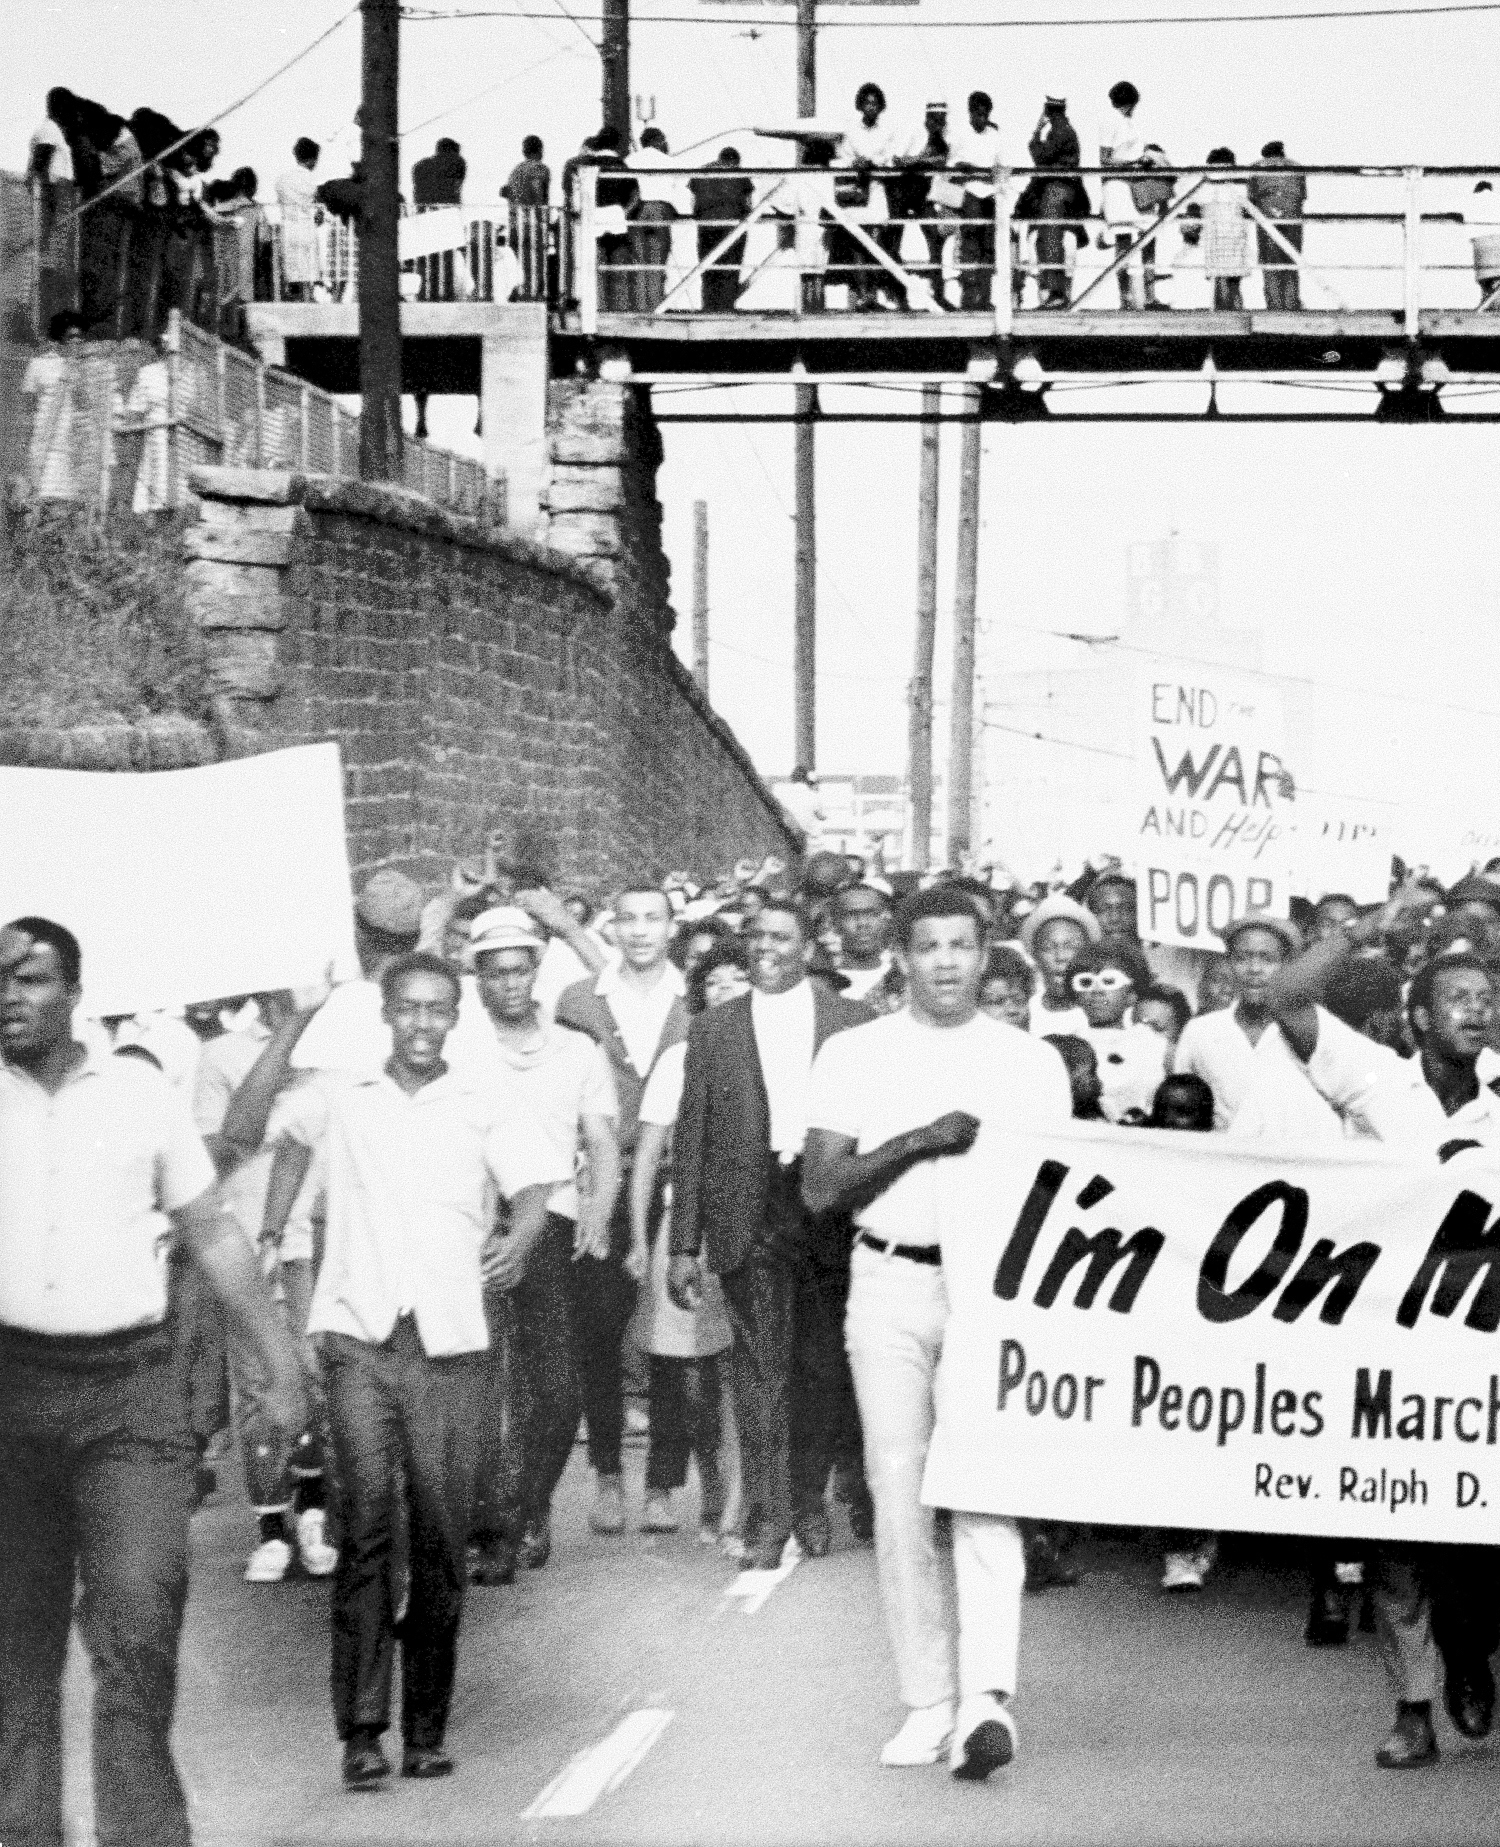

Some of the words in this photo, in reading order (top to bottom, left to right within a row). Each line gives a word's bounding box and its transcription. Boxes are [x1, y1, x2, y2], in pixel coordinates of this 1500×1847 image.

[1151, 683, 1218, 728] END
[1150, 735, 1284, 808] WAR
[1140, 805, 1208, 839] AND
[993, 1158, 1166, 1315] I'm
[1196, 1178, 1382, 1327] On
[996, 1338, 1106, 1422] Poor
[1130, 1354, 1325, 1448] Peoples
[1254, 1462, 1321, 1502] Rev.
[1339, 1465, 1429, 1514] Ralph
[1455, 1470, 1488, 1509] D.
